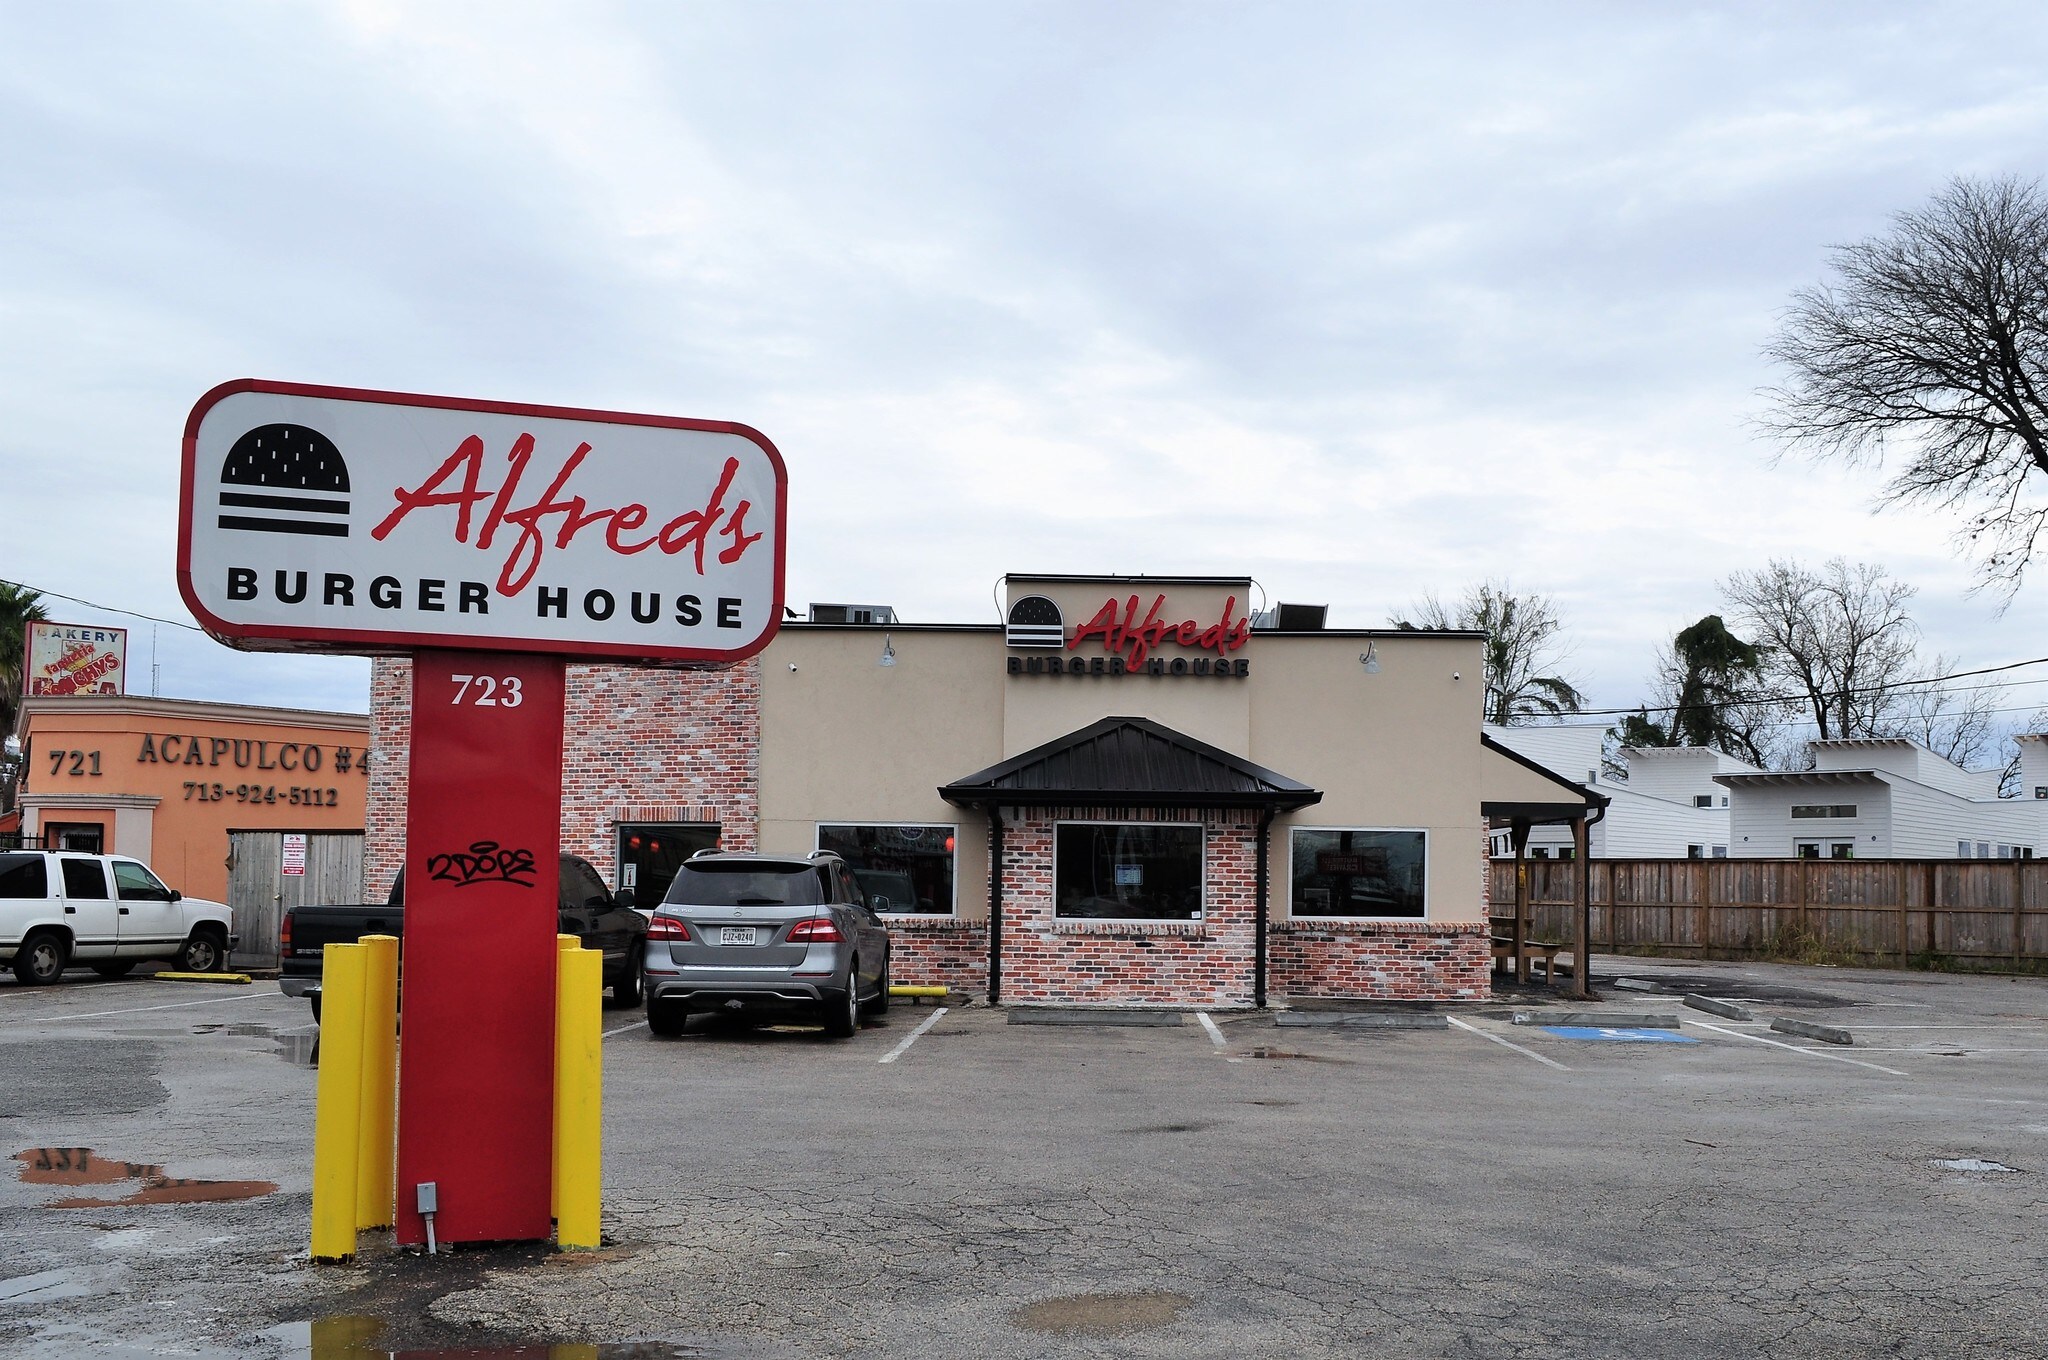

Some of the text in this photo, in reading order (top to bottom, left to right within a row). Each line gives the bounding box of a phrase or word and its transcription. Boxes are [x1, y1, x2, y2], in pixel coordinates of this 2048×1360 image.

[371, 432, 763, 598] Alfreds
[226, 567, 743, 629] BURGER HOUSE
[1066, 594, 1252, 673] Alfreds
[1007, 655, 1249, 677] BURGER HOUSE
[450, 673, 524, 708] 723
[49, 750, 103, 776] 721
[137, 732, 323, 773] ACAPULCO
[183, 781, 339, 807] 713-924-5112
